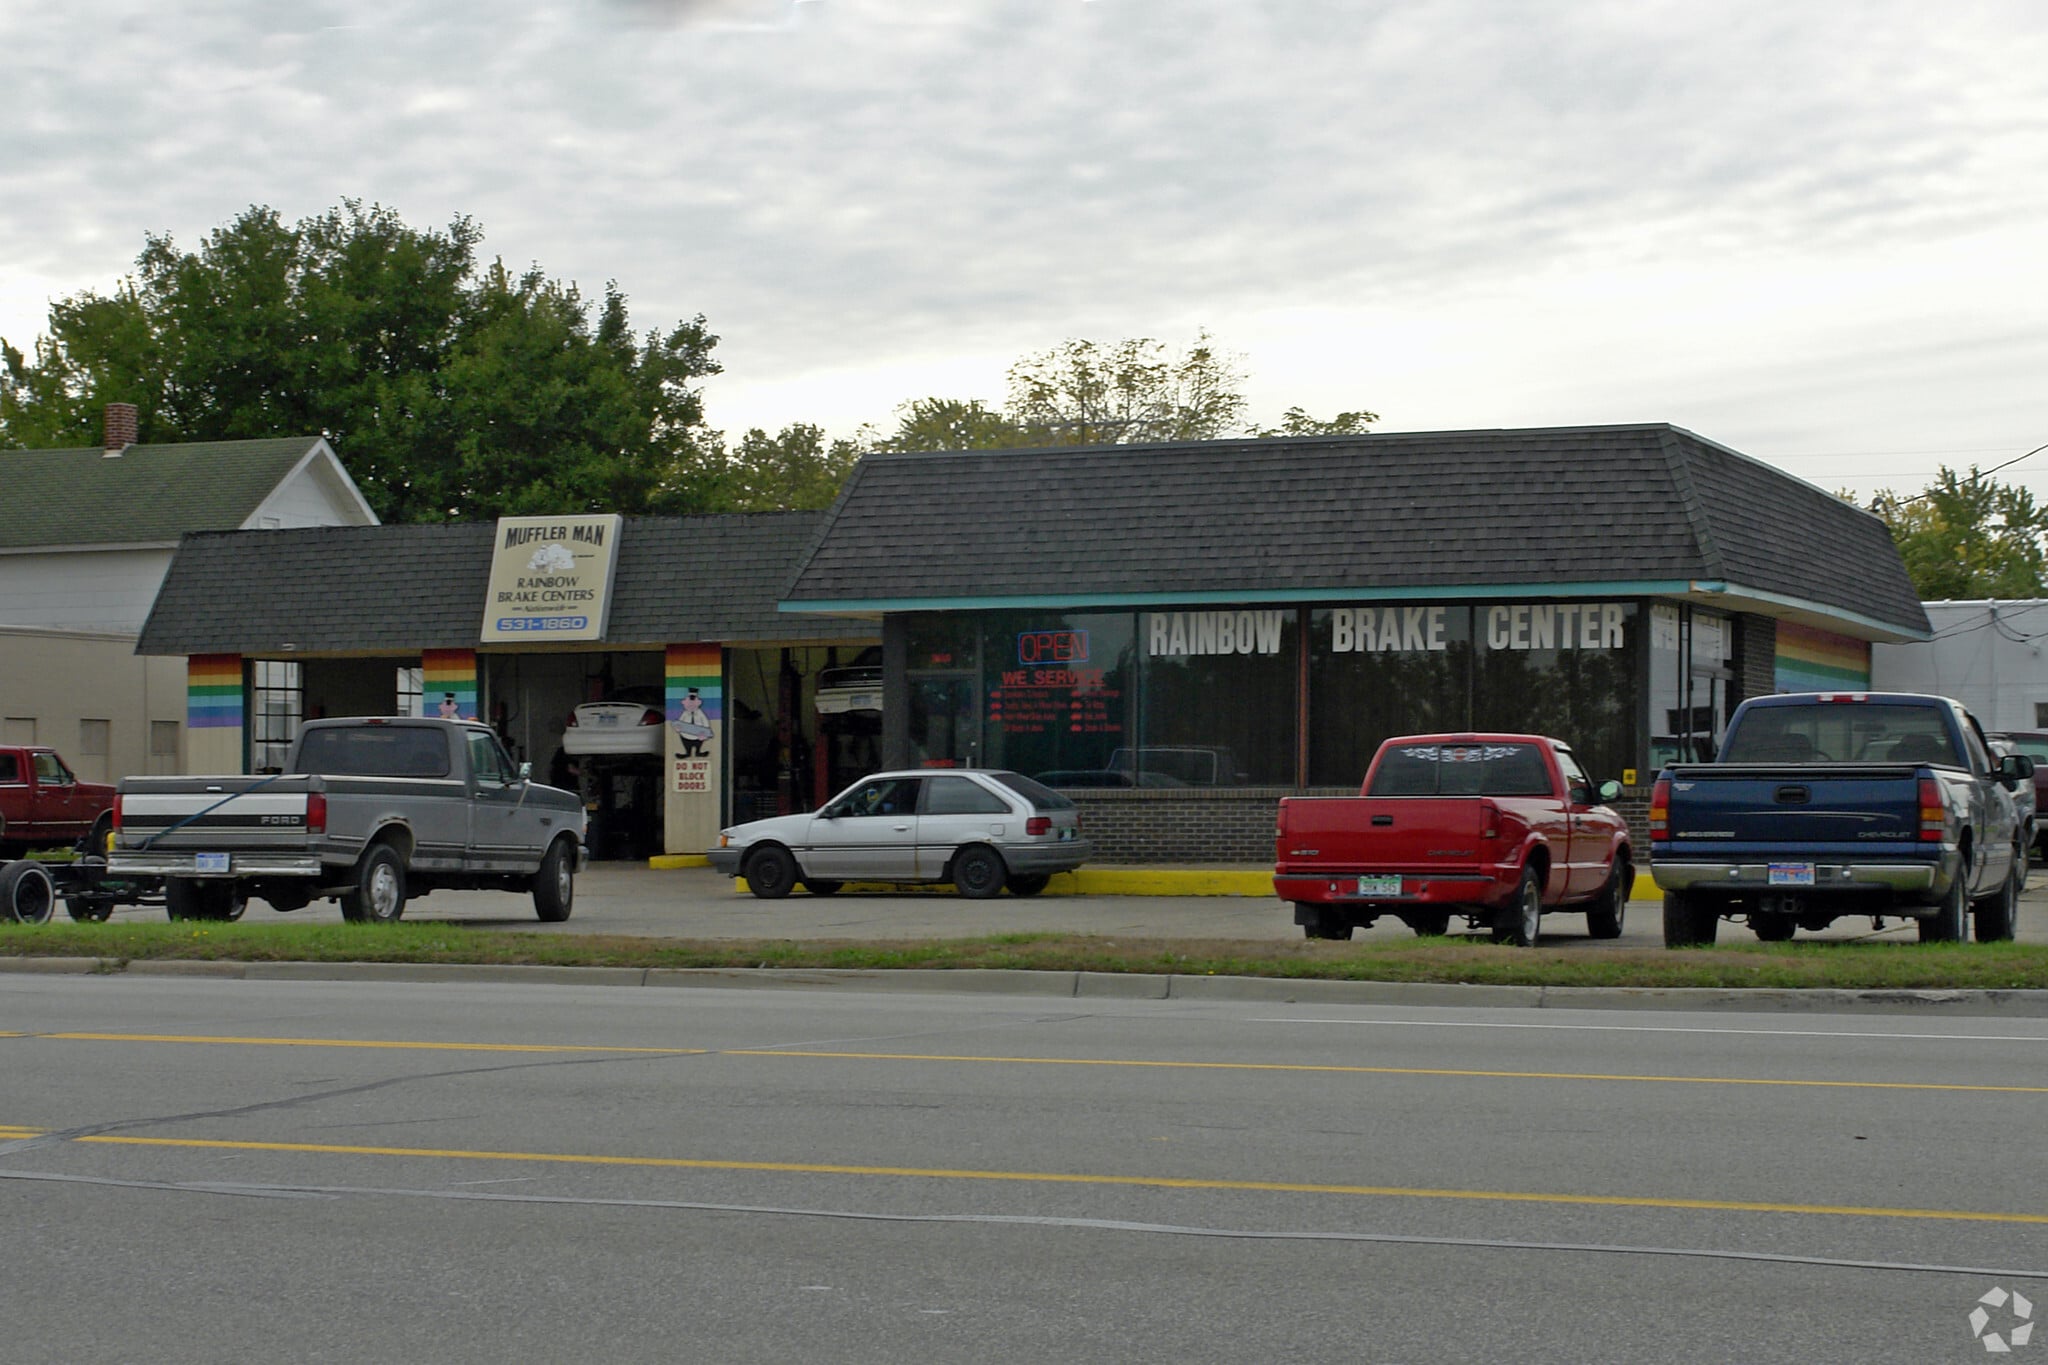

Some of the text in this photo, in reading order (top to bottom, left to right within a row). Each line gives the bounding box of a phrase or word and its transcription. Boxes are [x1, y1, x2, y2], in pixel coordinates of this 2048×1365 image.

[504, 524, 605, 549] MUFFLER MAN
[517, 576, 580, 589] RAINBOW
[497, 589, 595, 603] BRAKE CENTERS
[499, 617, 584, 631] 531-1860
[1149, 603, 1625, 656] RAINBOW BRAKE CENTER
[1020, 632, 1088, 662] OPEN
[1002, 669, 1105, 686] WE SERVICE
[676, 762, 708, 770] DO NOT
[679, 772, 705, 780] BLOCK
[678, 781, 706, 790] DOORS
[261, 816, 300, 825] FORD
